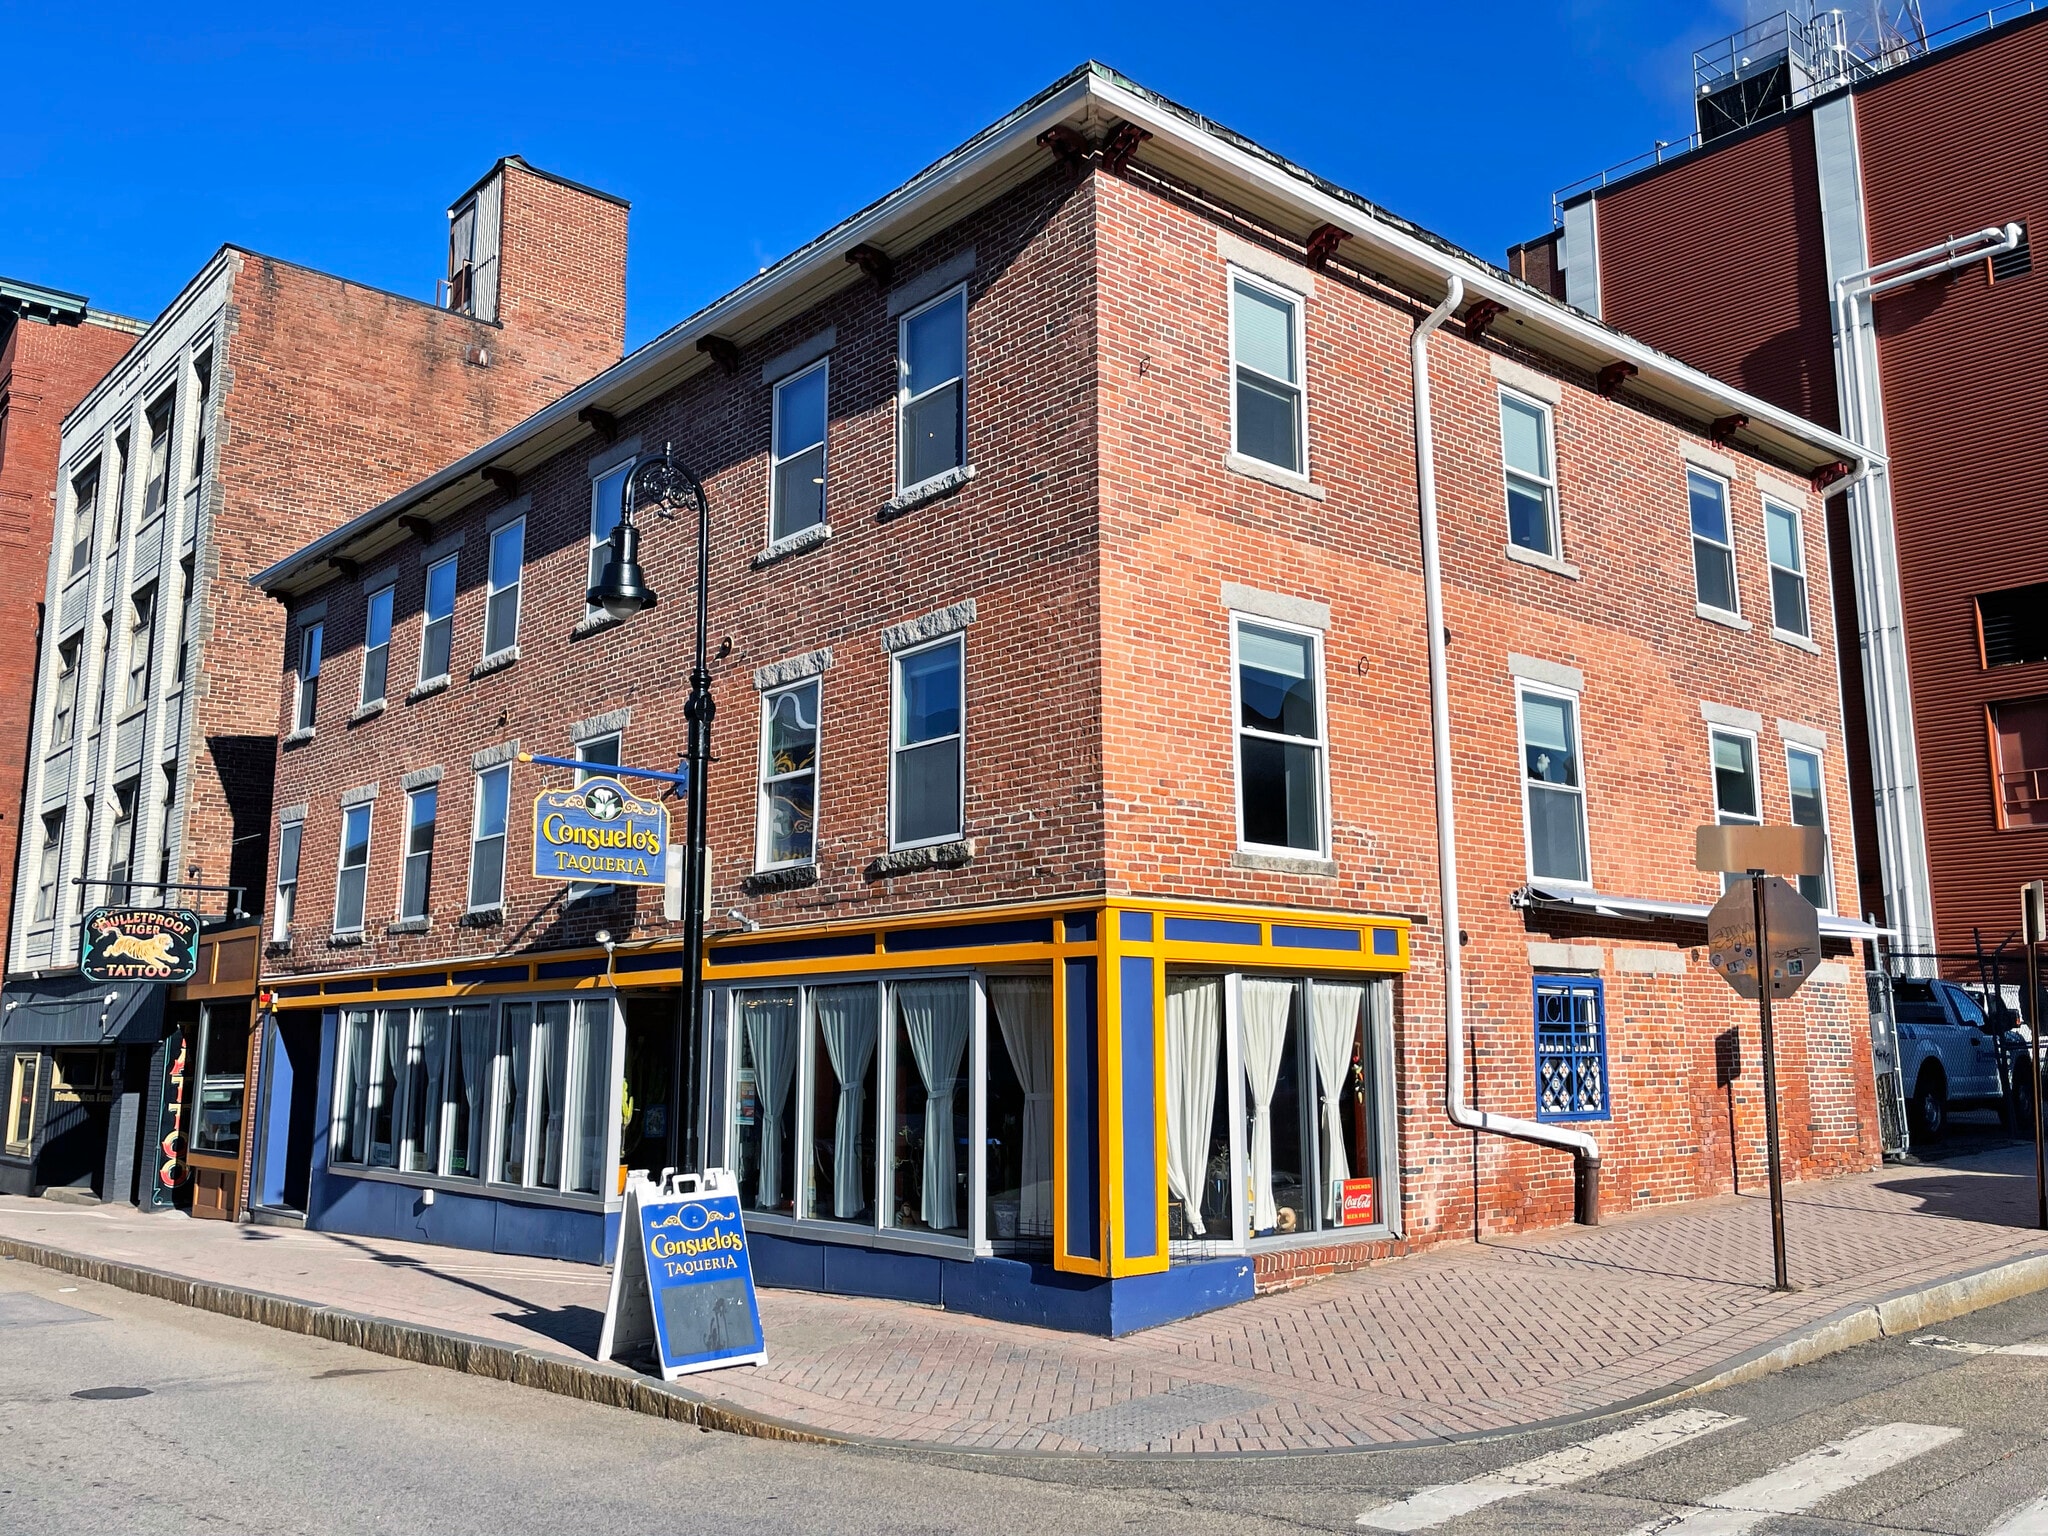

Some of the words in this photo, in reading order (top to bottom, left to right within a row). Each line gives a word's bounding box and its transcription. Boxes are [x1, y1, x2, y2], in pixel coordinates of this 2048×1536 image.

[542, 813, 661, 855] Consuelo's
[554, 851, 648, 876] TAQUERIA
[94, 911, 191, 935] BULLETPROOF
[124, 924, 160, 935] TIGER
[106, 964, 171, 977] TATTOO
[651, 1226, 743, 1259] Consuelo's
[664, 1254, 738, 1277] TAQUERIA
